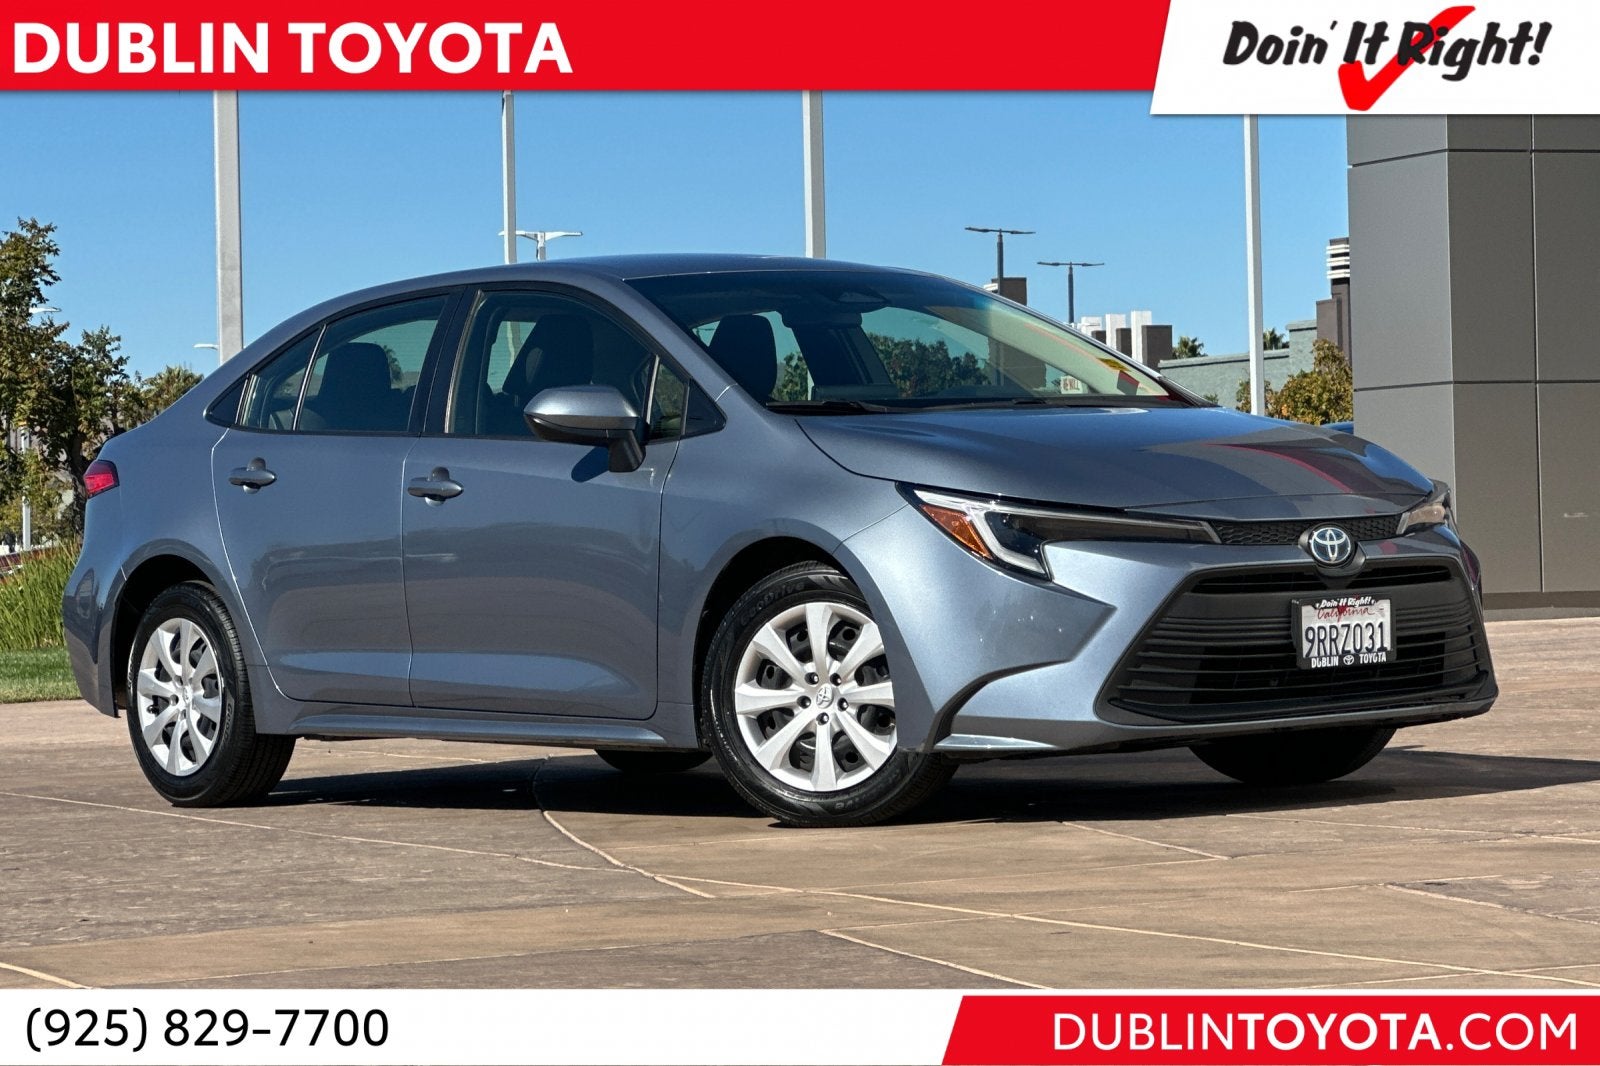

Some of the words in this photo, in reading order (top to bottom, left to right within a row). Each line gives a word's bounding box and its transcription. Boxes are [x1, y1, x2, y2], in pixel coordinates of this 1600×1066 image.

[1347, 596, 1371, 607] Right!
[1304, 621, 1387, 657] 9RRZ031
[1311, 656, 1339, 669] DUBLIN
[1359, 652, 1386, 664] TOYOTA
